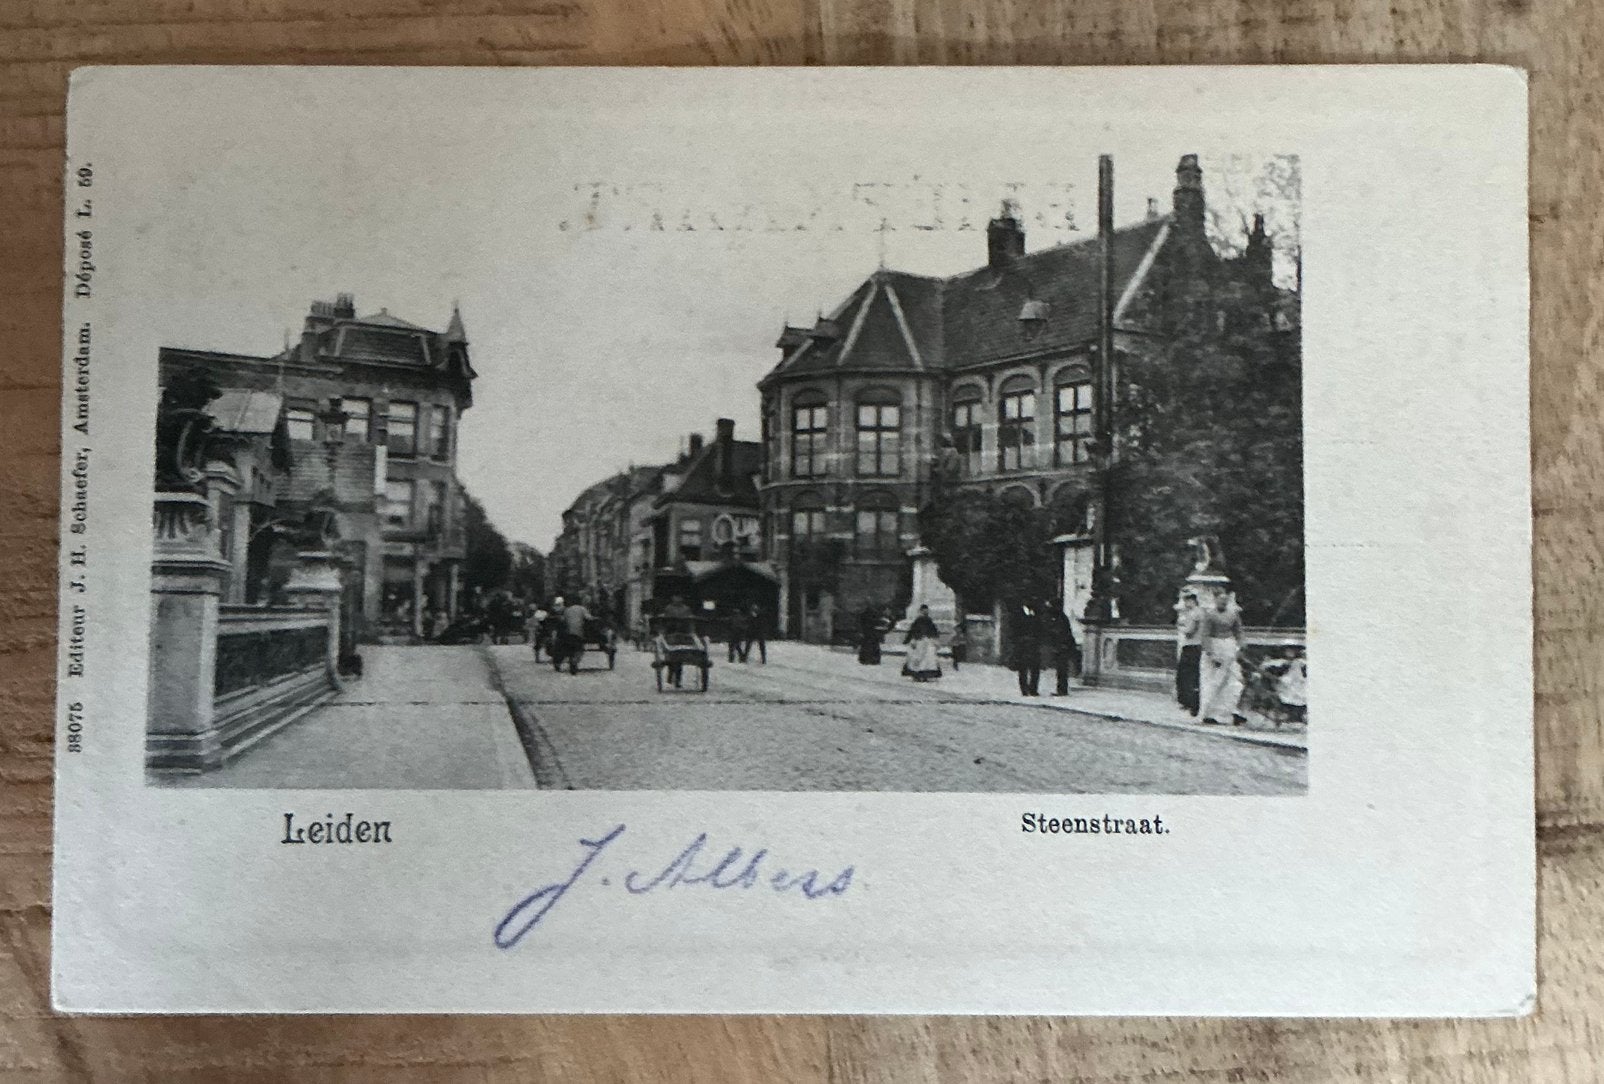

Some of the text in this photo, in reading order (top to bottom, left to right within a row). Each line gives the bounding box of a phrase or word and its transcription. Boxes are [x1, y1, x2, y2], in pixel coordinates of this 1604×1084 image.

[75, 199, 92, 218] L.
[74, 230, 96, 299] Déposé
[73, 322, 92, 436] Amsterdam.
[70, 447, 92, 535] Schaefer,
[69, 543, 87, 567] H.
[70, 574, 86, 594] J.
[67, 605, 86, 678] Editeur
[281, 813, 392, 844] Leiden
[1022, 812, 1170, 834] Steenstraat.
